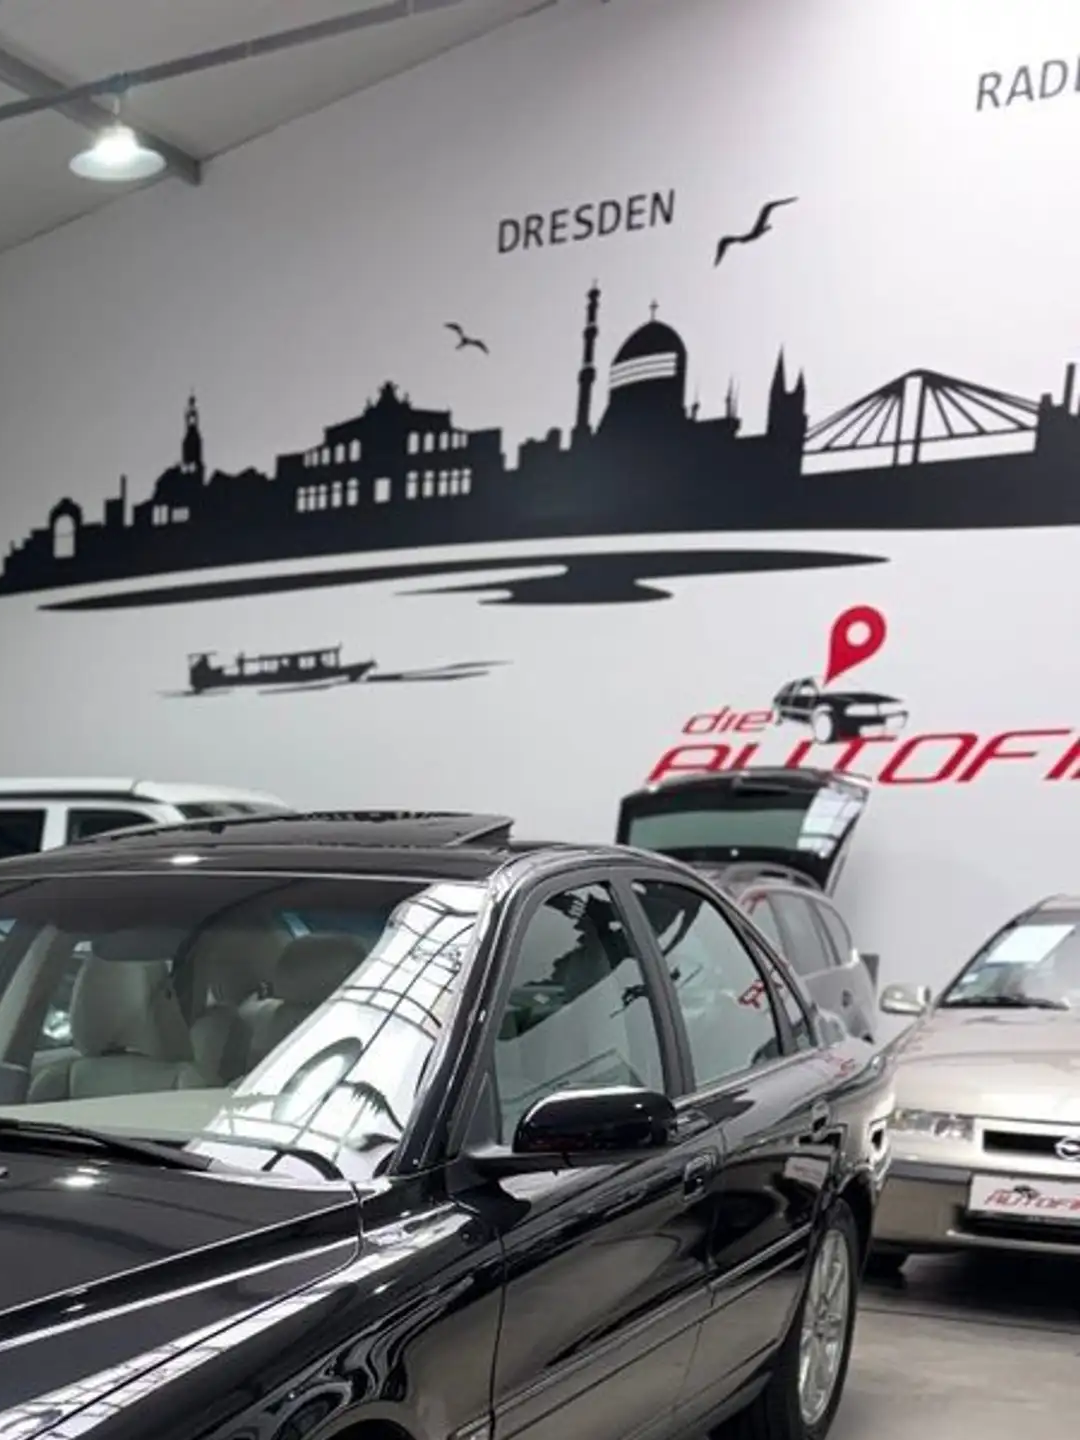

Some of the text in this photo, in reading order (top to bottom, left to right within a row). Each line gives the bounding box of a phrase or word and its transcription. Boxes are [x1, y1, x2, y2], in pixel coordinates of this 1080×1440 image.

[497, 189, 675, 254] DRESDEN
[682, 706, 775, 735] die
[648, 727, 1080, 784] AUTOFI
